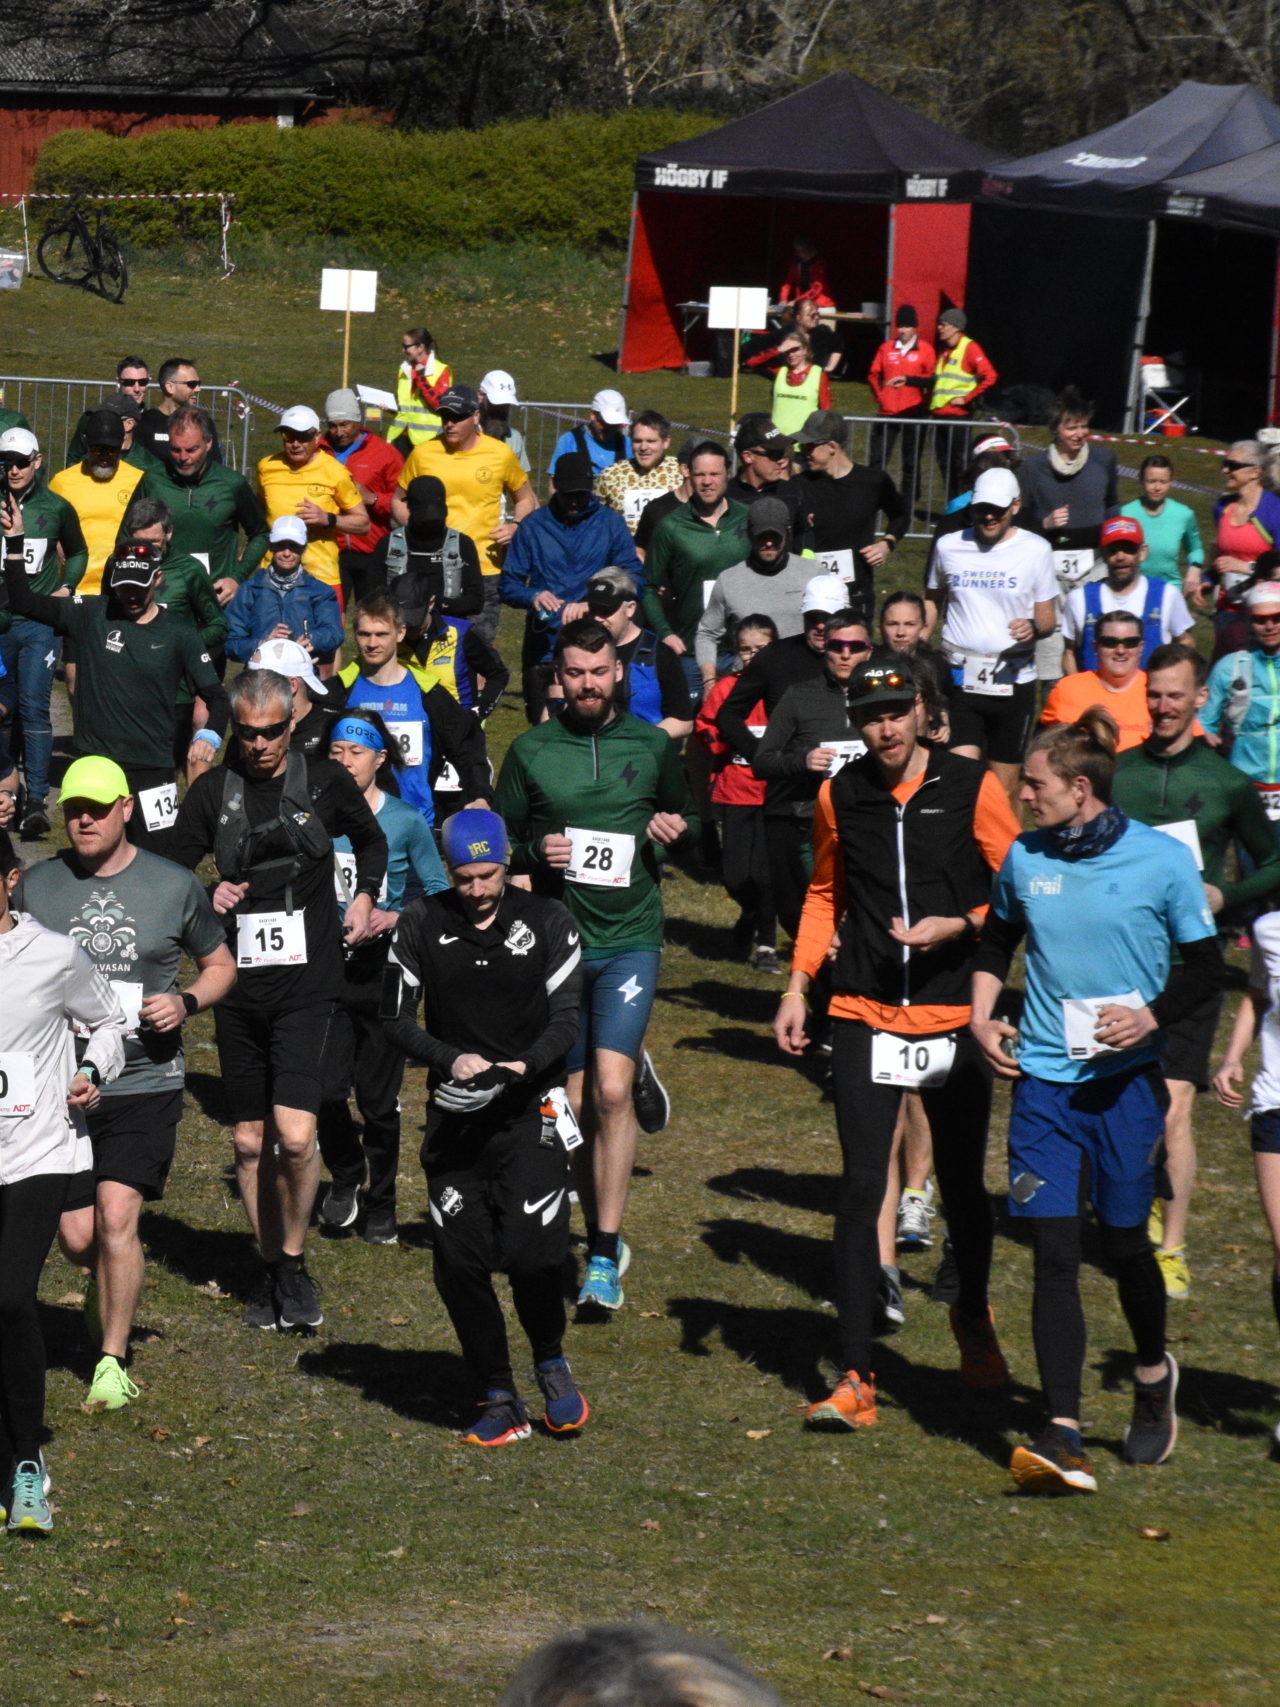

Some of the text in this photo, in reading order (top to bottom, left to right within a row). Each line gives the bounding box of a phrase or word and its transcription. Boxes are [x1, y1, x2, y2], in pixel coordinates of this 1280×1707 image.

[655, 163, 728, 188] HÖGBY IF
[963, 570, 1006, 578] SWEDEN
[1062, 559, 1078, 574] 31
[346, 725, 376, 740] GORE
[582, 845, 613, 871] 28
[255, 927, 284, 952] 15
[899, 1045, 930, 1071] 10
[13, 1104, 31, 1112] ADT
